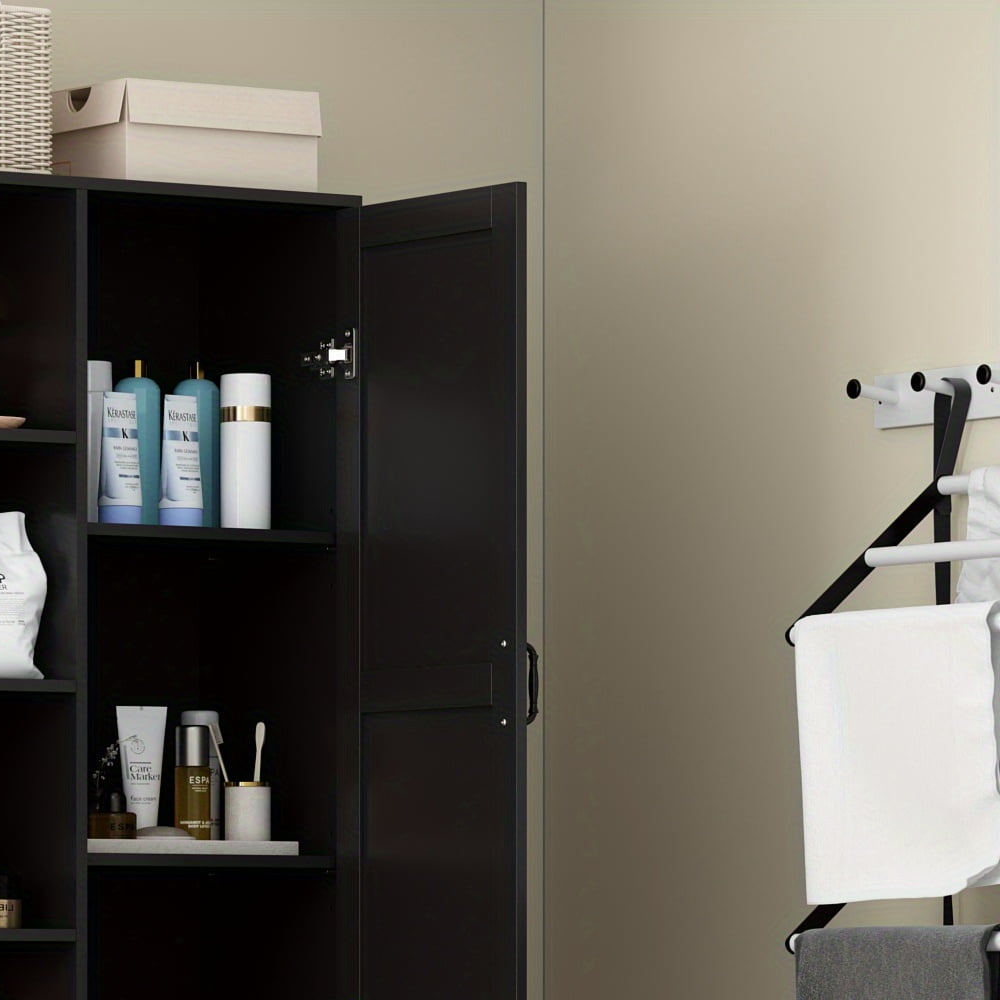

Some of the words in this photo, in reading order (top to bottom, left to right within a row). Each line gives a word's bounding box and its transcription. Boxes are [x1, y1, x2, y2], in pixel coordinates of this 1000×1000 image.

[129, 765, 151, 773] Care
[131, 773, 160, 781] Market
[189, 776, 210, 784] ESPA
